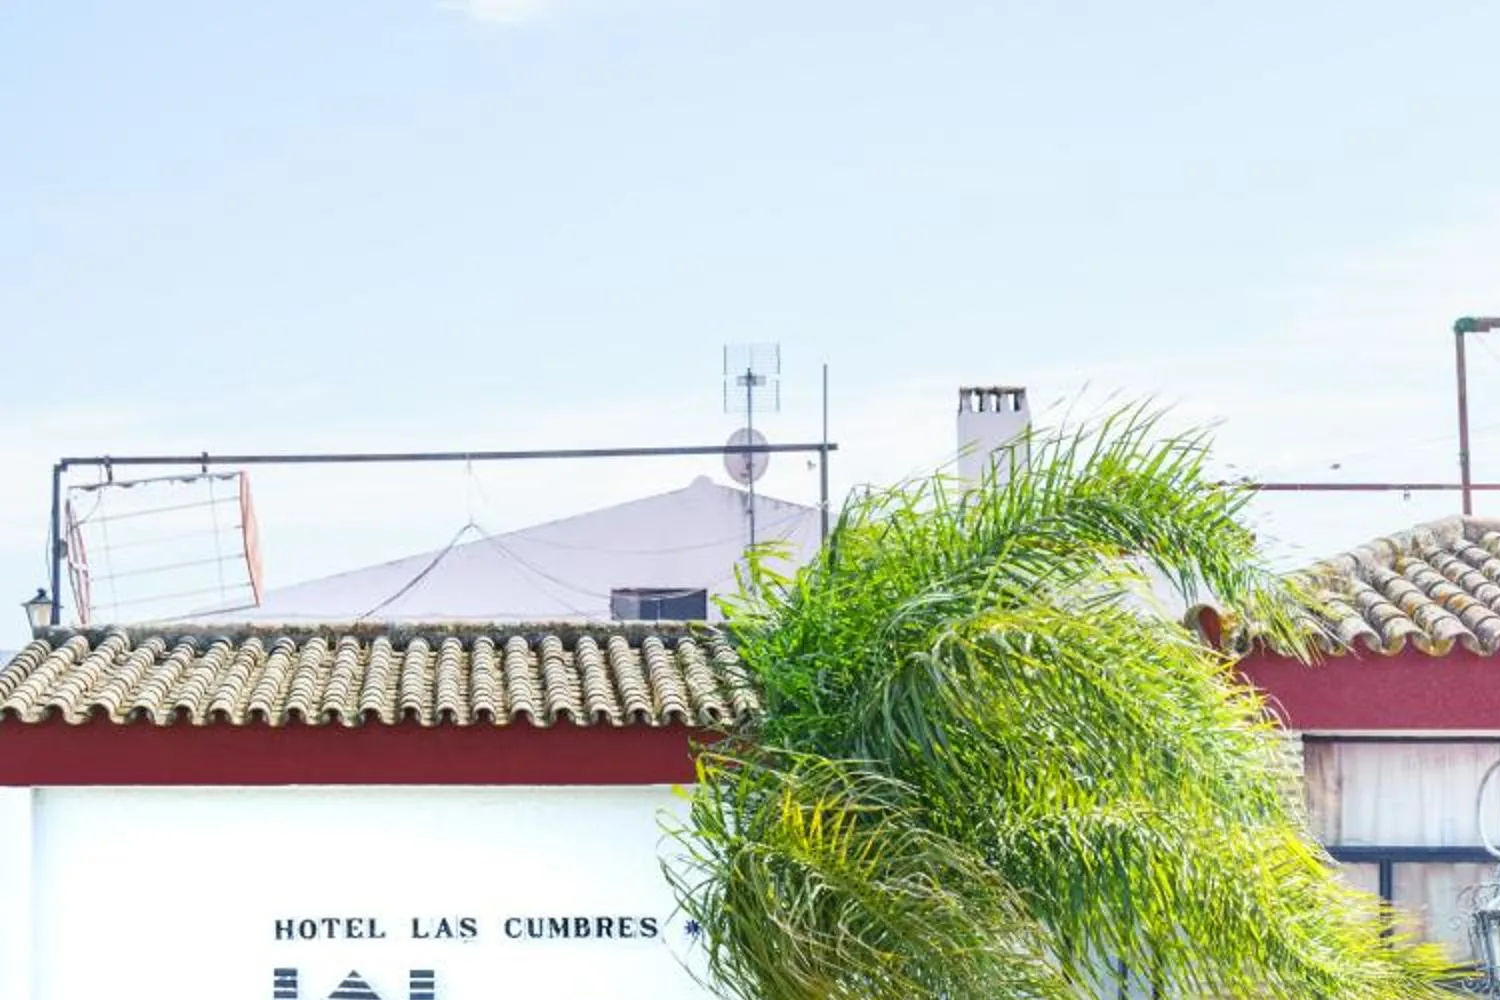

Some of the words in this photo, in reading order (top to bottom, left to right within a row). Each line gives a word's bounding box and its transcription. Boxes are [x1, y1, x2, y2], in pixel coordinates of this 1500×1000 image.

[274, 917, 386, 940] HOTEL
[411, 917, 478, 939] LAS
[504, 916, 658, 939] CUMBRES
